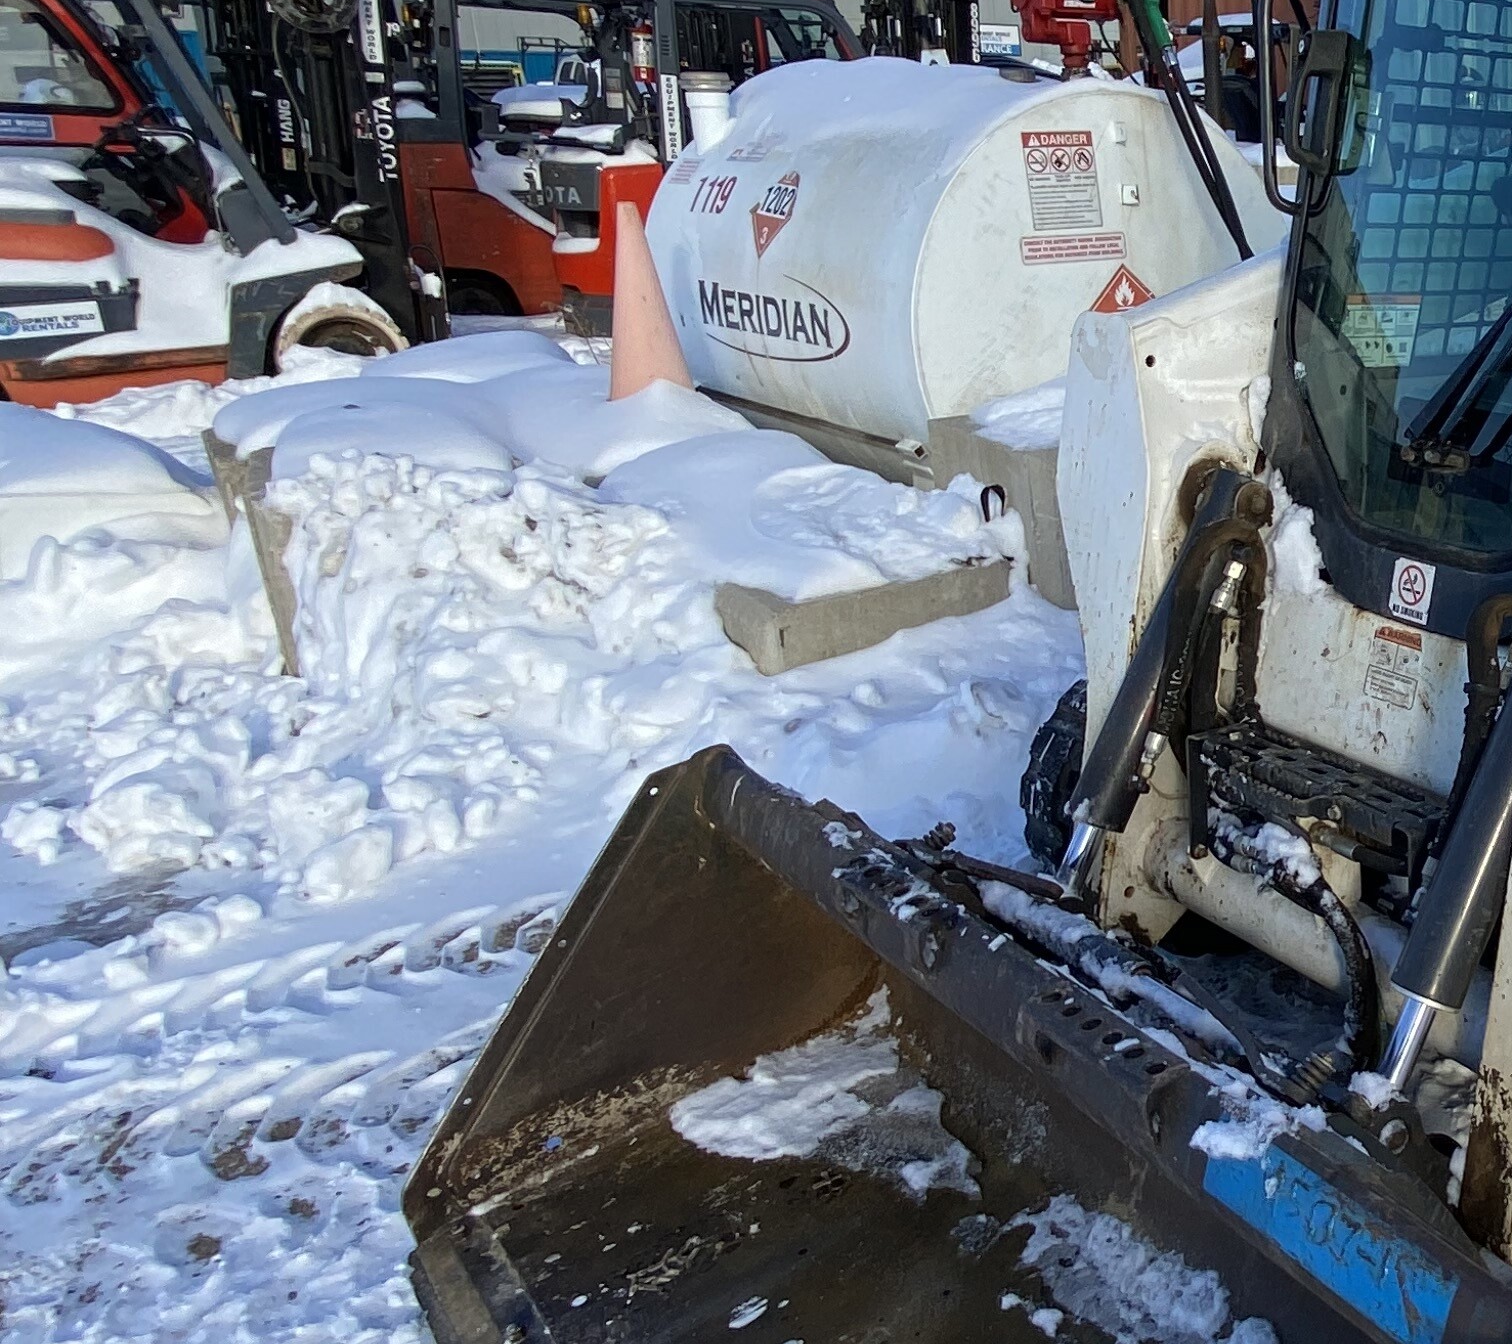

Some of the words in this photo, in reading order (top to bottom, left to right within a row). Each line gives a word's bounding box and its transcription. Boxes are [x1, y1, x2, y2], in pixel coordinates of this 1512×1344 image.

[366, 30, 377, 60] WORLD
[666, 77, 676, 129] EQUIPMENT
[372, 96, 398, 183] TOYOTA
[669, 132, 678, 159] WORLD
[1041, 134, 1087, 145] DANGER
[690, 175, 737, 214] 1119
[761, 186, 795, 216] 1202
[759, 227, 768, 244] 3
[22, 321, 80, 332] RENTALS
[63, 313, 95, 321] WORLD
[698, 279, 834, 349] MERIDIAN
